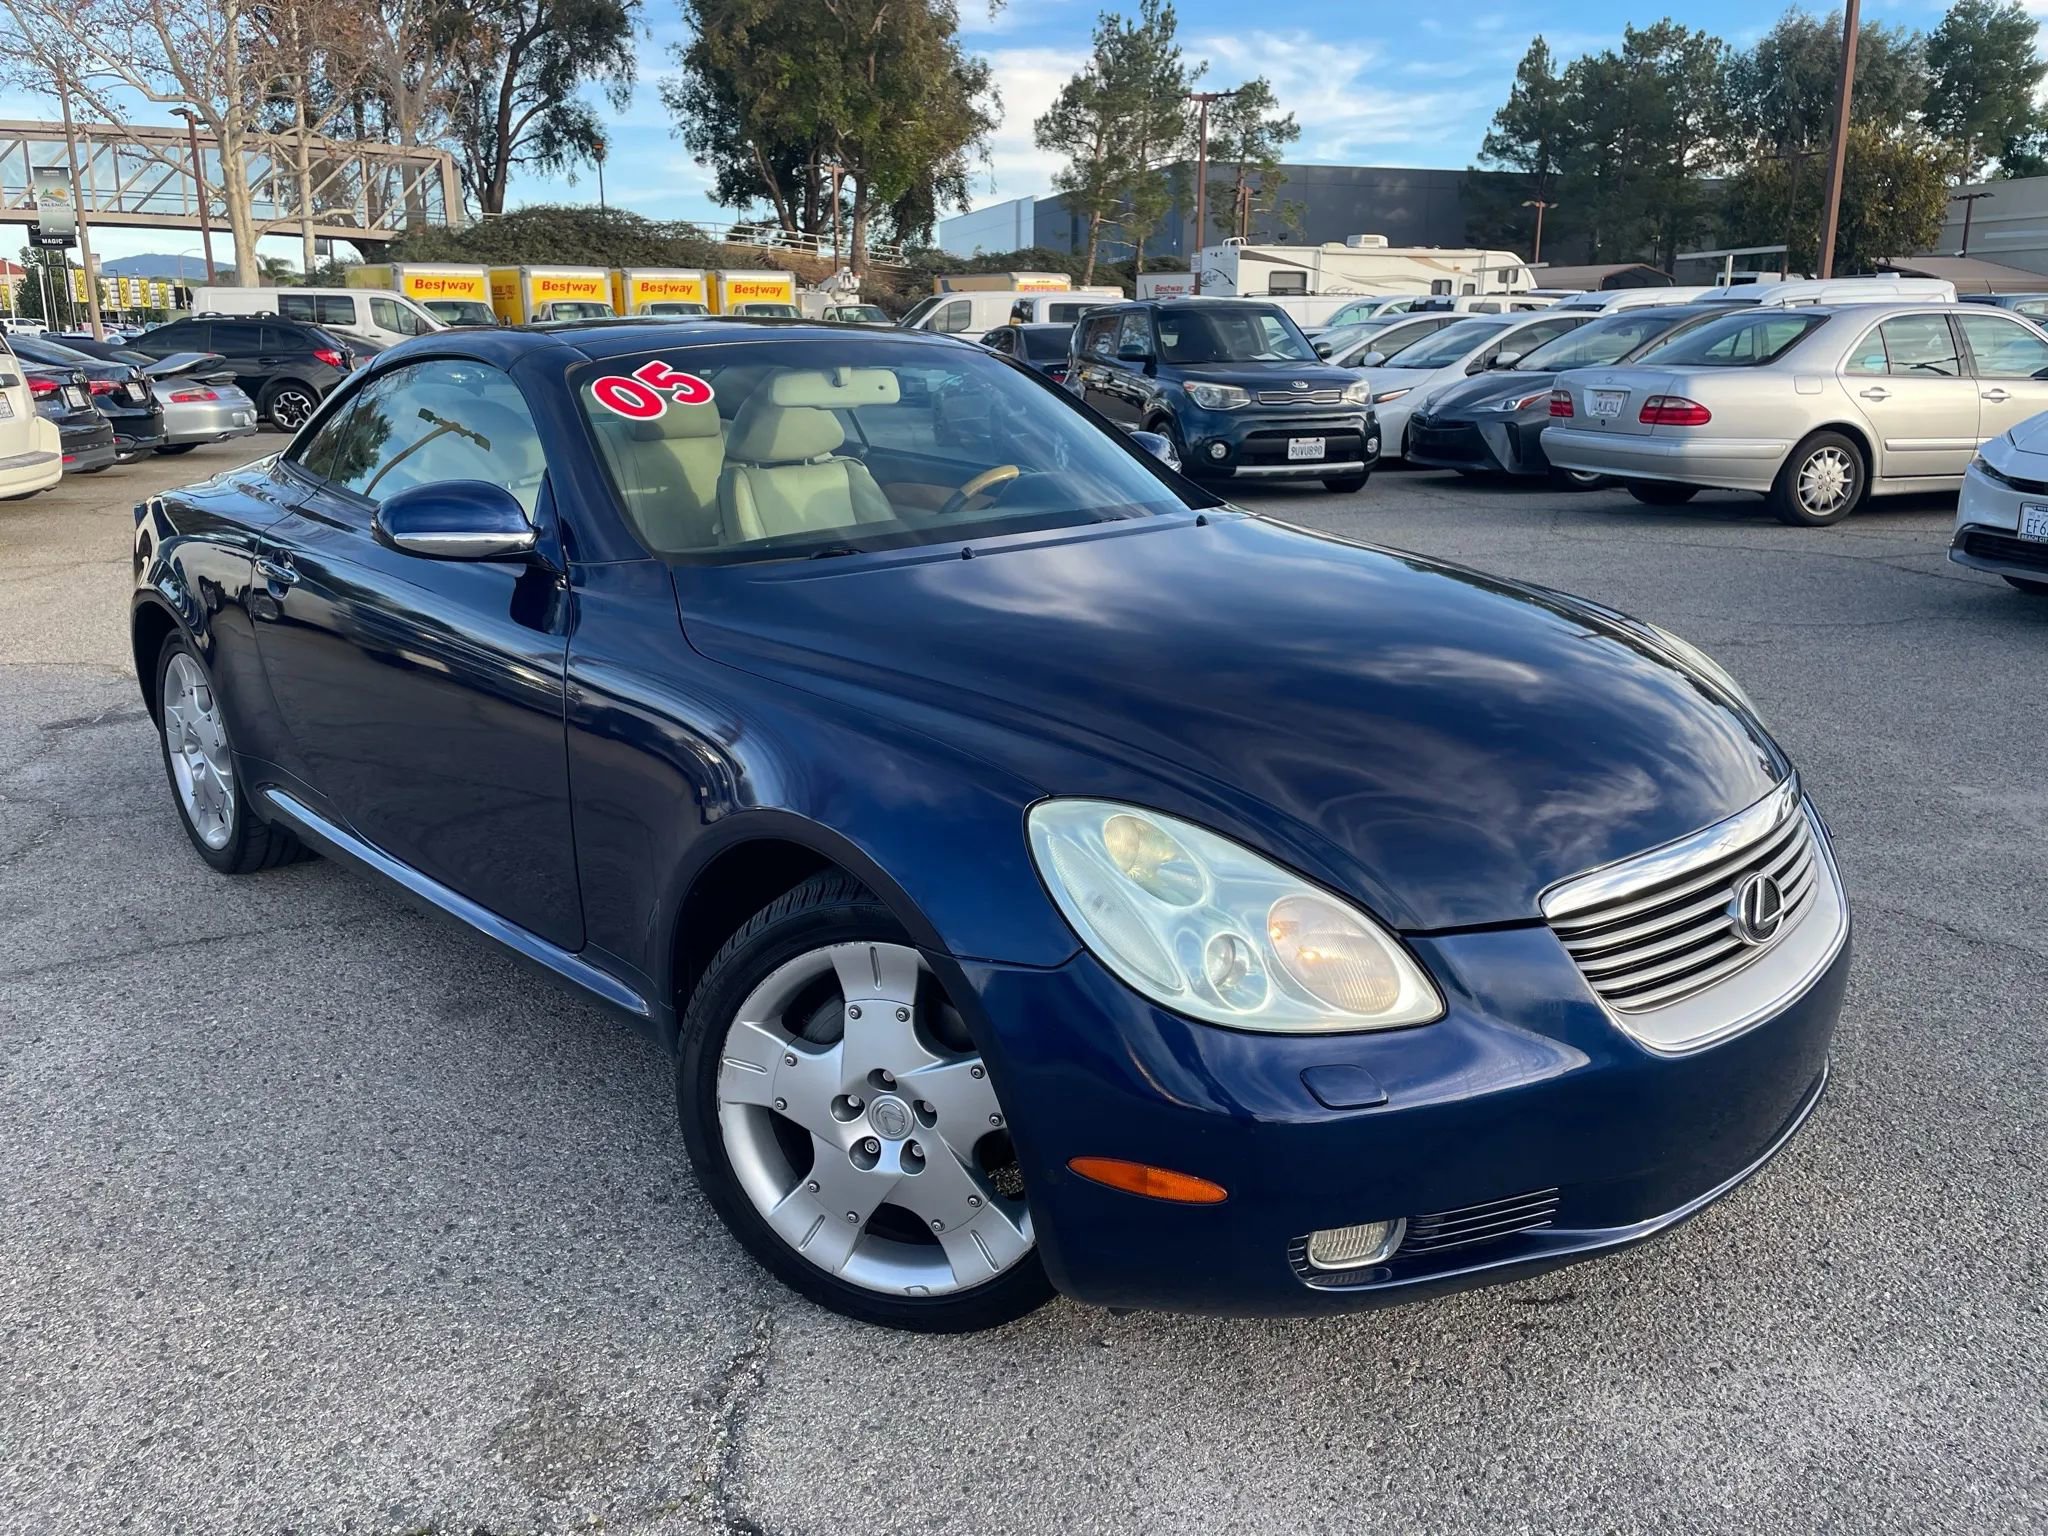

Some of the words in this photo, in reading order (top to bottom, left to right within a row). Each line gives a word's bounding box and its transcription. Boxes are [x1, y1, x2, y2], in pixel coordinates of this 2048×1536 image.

[414, 279, 475, 293] Bestway
[542, 281, 597, 294] Bestway
[640, 282, 693, 295] Bestway
[734, 284, 783, 297] Bestway
[591, 359, 715, 421] 05
[2026, 518, 2048, 536] EF6
